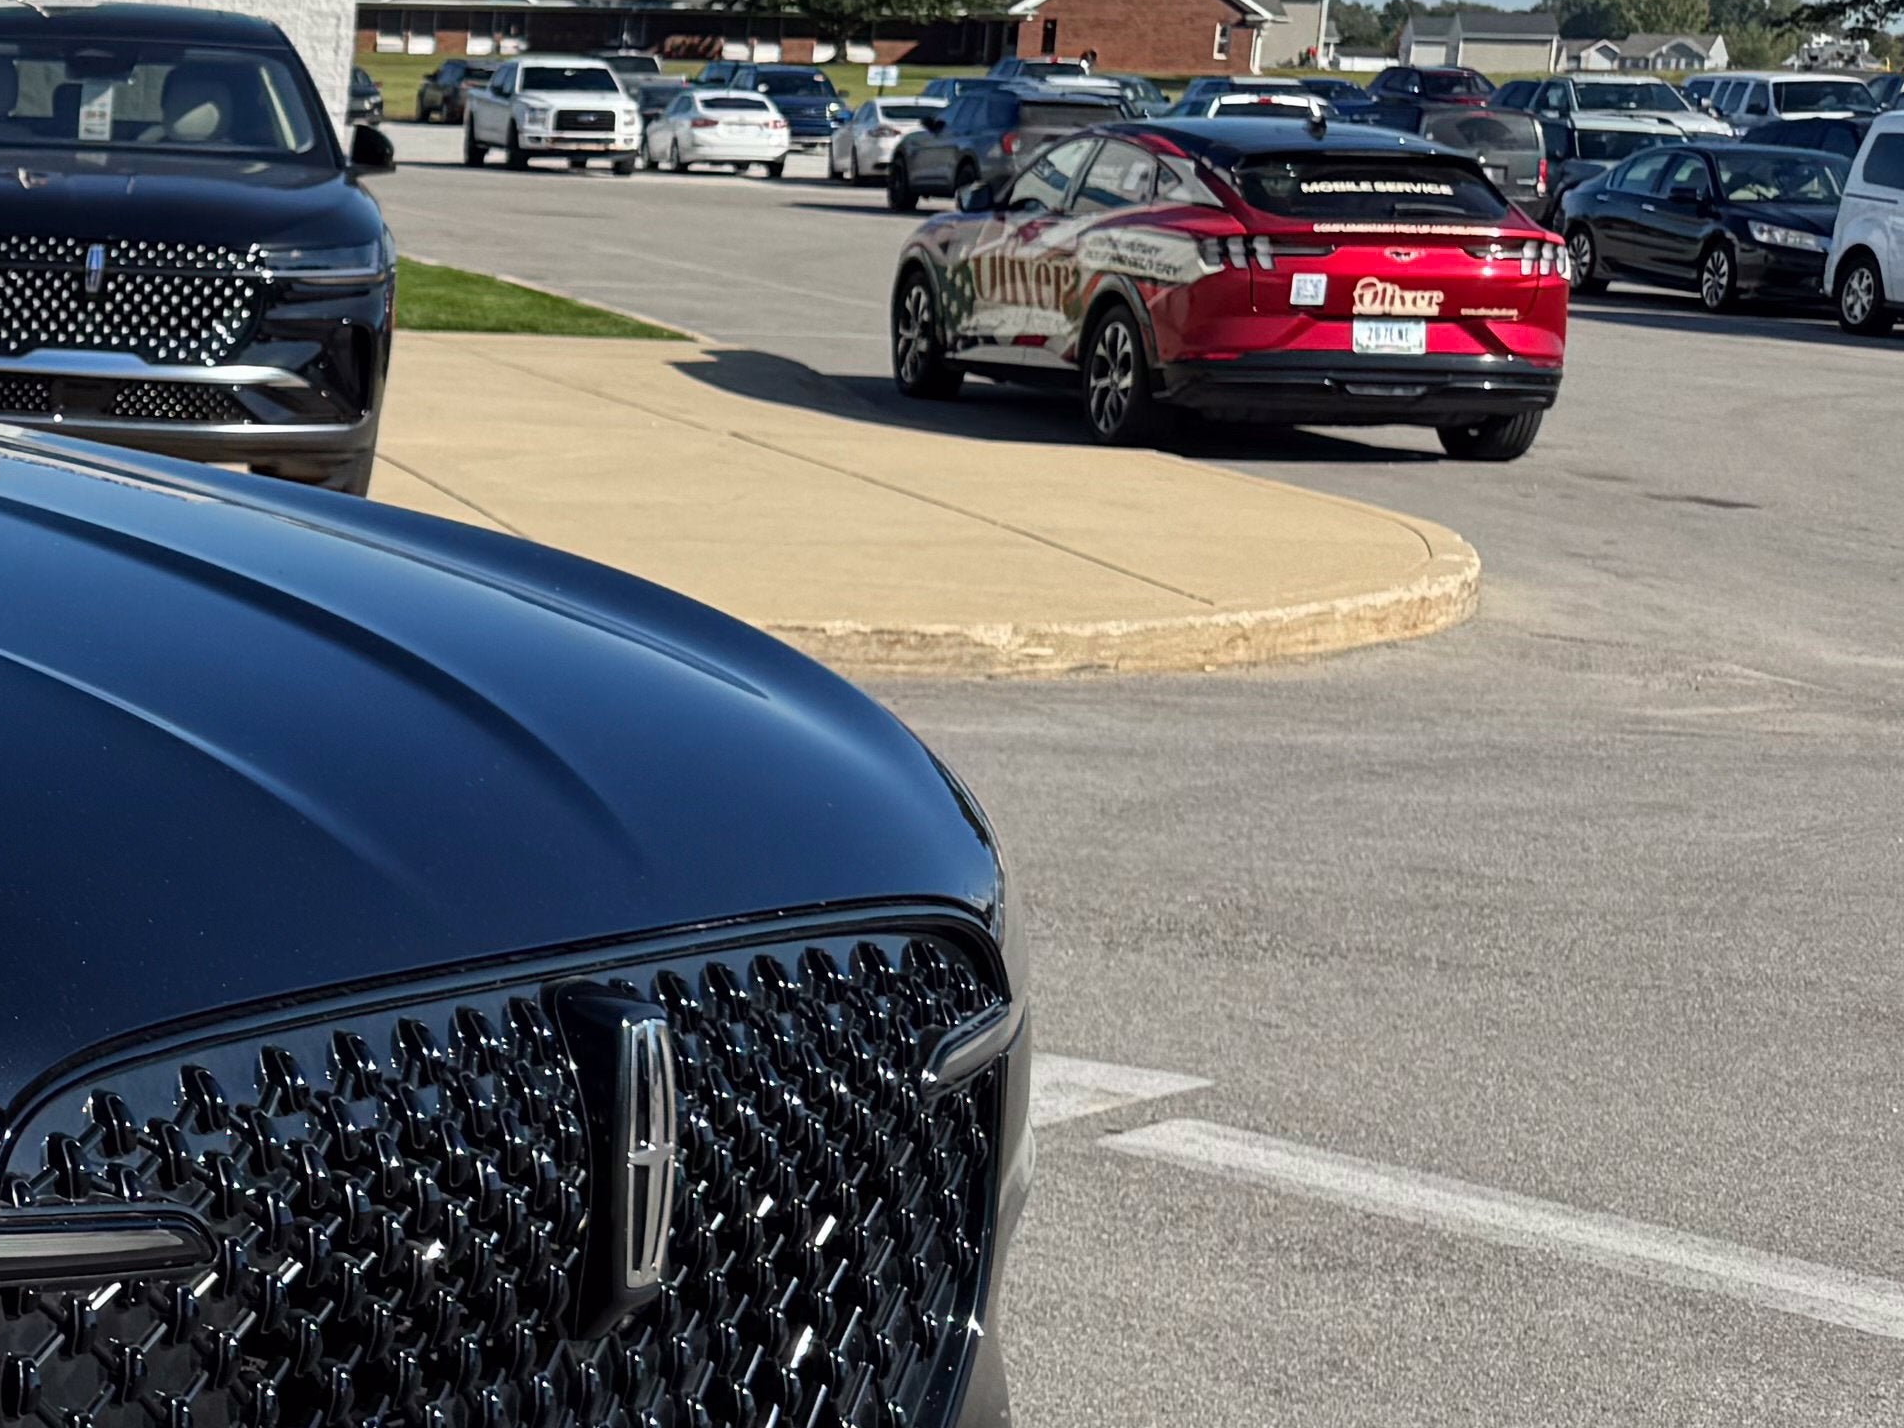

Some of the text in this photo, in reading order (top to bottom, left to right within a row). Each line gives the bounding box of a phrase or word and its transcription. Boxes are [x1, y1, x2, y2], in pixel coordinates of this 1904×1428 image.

[1300, 181, 1454, 196] MOBILE SERVICE
[1352, 276, 1445, 316] Oliver
